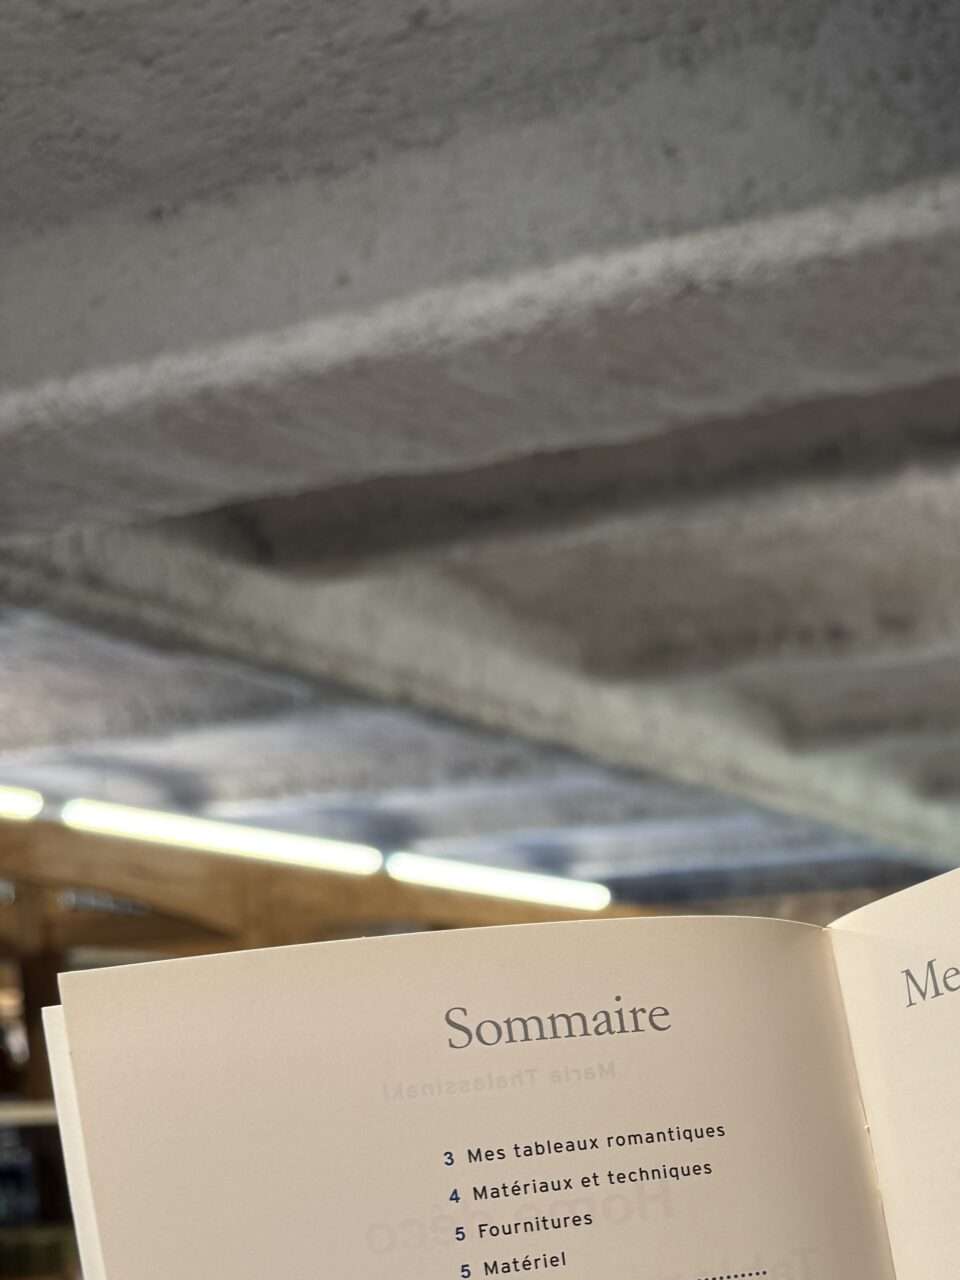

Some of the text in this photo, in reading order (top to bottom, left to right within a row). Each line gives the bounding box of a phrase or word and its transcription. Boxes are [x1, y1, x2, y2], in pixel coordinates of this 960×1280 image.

[445, 995, 672, 1050] Sommaire
[444, 1126, 726, 1167] 3 Mes tableaux romantiques
[449, 1163, 713, 1204] 4 Matériaux et techniques
[455, 1214, 593, 1242] 5 Fournitures
[461, 1251, 566, 1279] 5 Matériel
